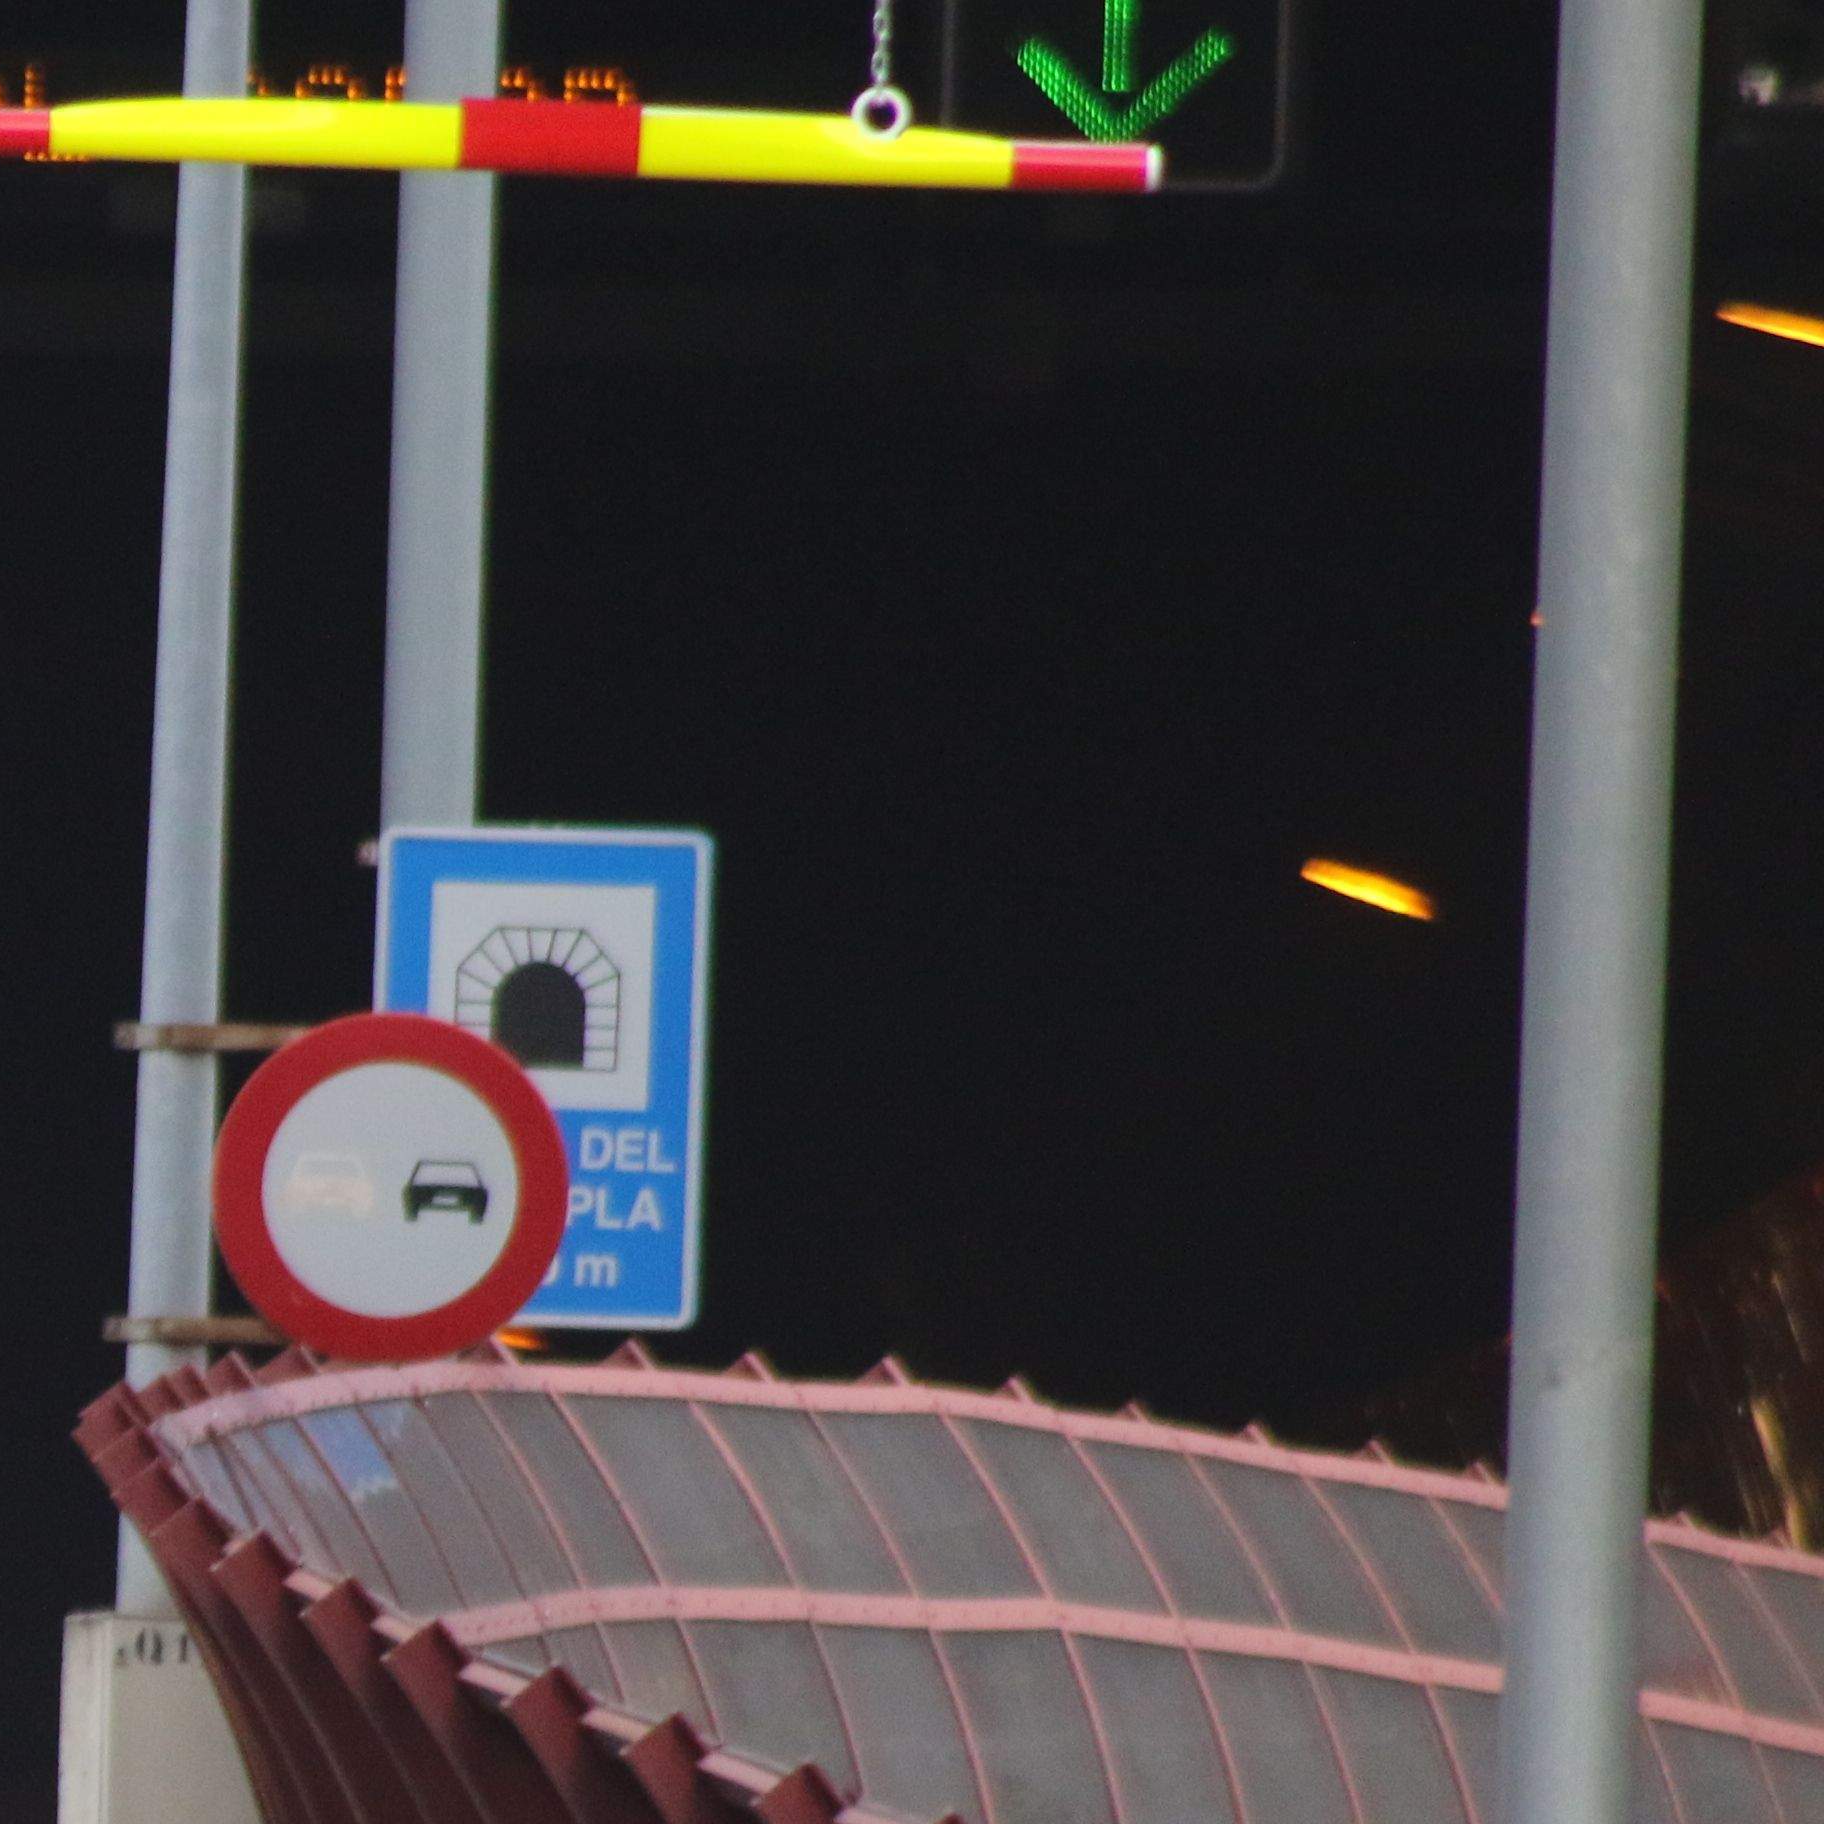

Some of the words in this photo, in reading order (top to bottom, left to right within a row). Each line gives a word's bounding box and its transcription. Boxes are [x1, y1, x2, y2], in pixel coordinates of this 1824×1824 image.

[579, 1125, 678, 1174] DEL
[566, 1184, 665, 1232] PLA
[574, 1252, 620, 1289] m
